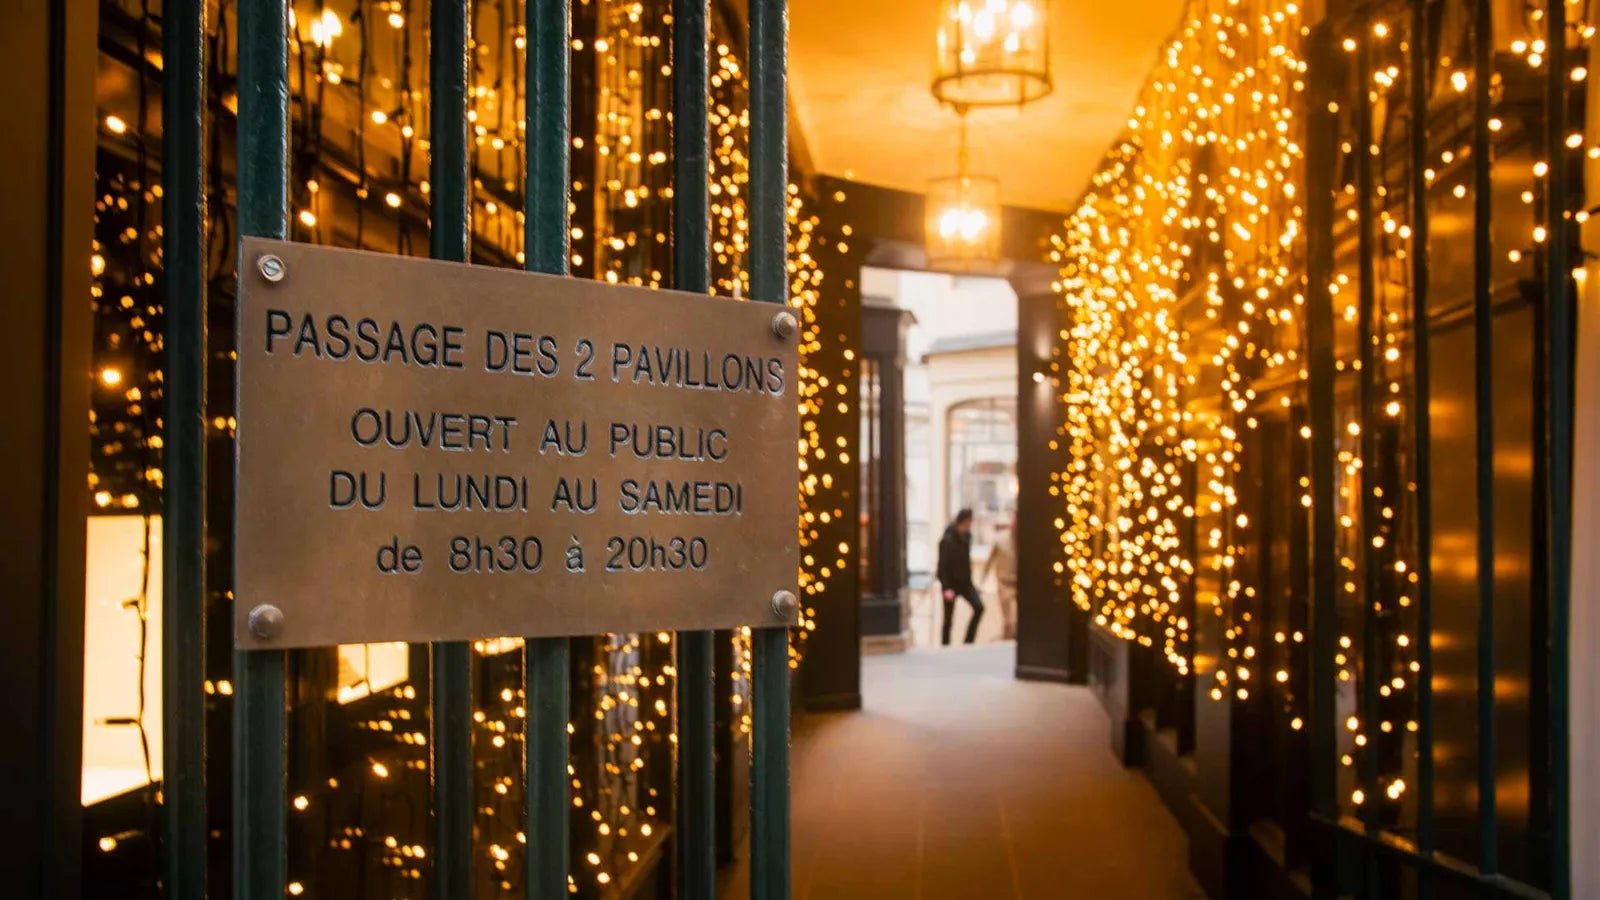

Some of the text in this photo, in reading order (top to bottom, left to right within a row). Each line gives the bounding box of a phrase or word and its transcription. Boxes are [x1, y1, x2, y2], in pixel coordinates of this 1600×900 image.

[266, 309, 785, 395] PASSAGE DES 2 PAVILLONS
[351, 408, 727, 462] OUVERT AU PUBLIC
[329, 471, 742, 516] DU LUNDI AU SAMEDI
[377, 536, 708, 574] de 8h30 à 20h30
